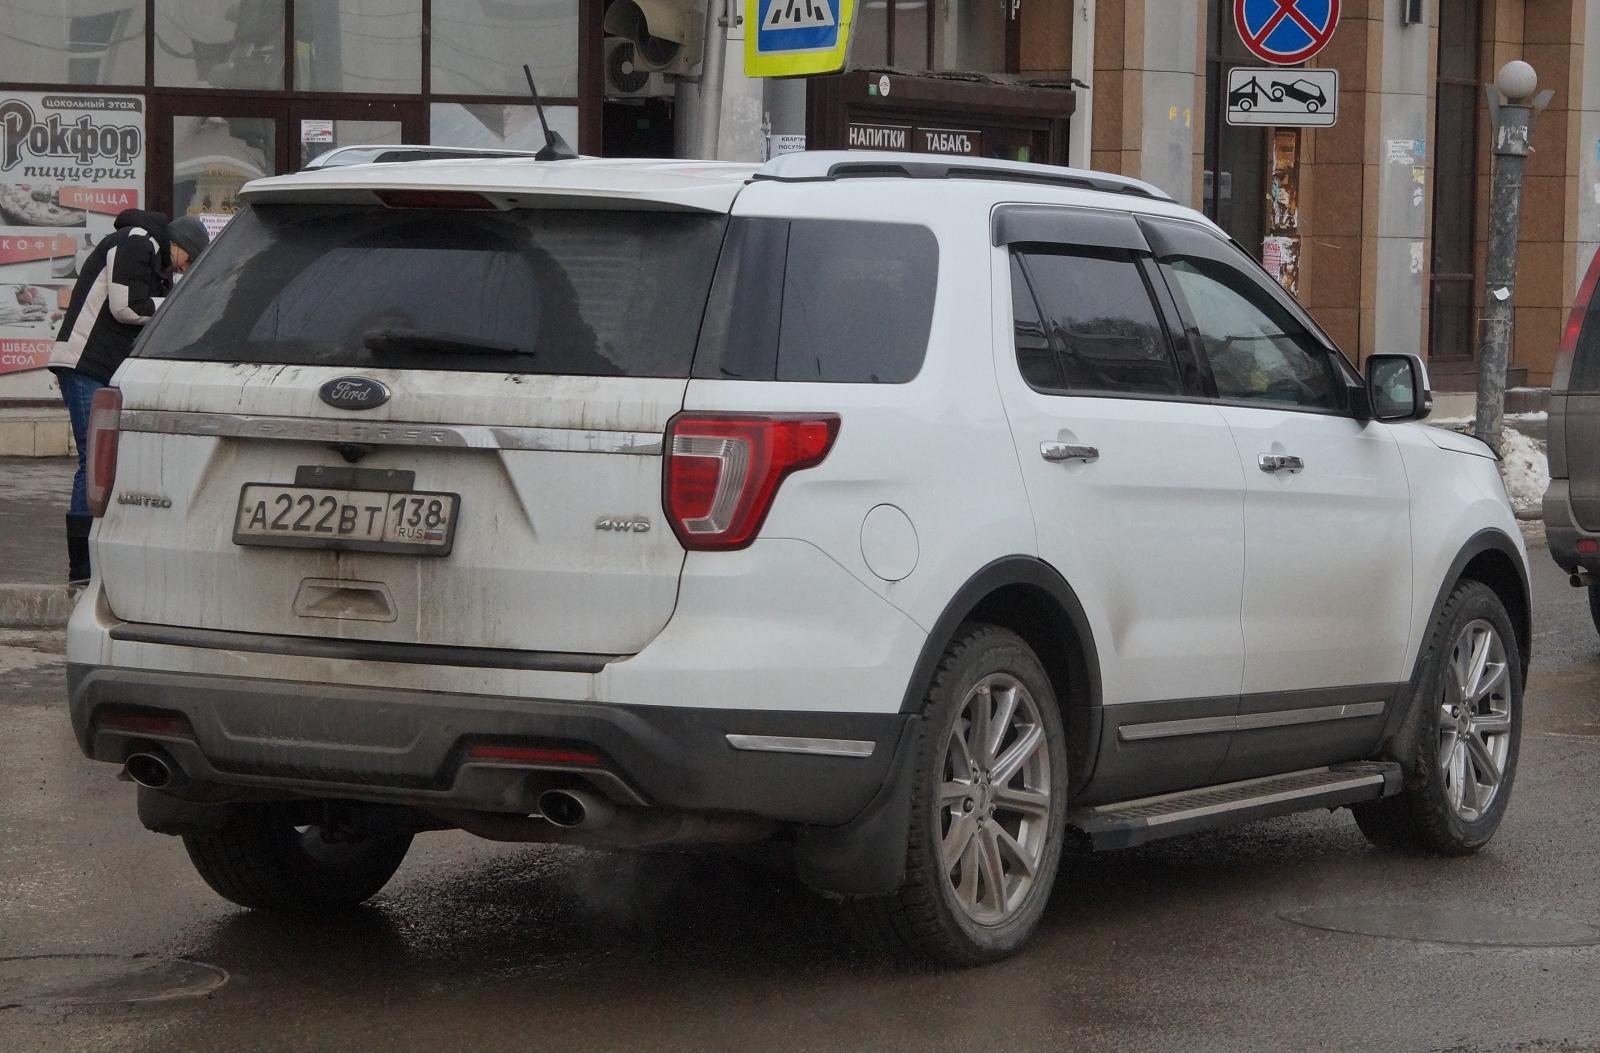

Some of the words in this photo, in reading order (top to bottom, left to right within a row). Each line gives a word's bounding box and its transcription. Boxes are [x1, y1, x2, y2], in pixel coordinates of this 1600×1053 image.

[0, 99, 141, 172] Рокфор
[849, 127, 905, 149] НАПИТКИ
[925, 132, 972, 153] ТАБАКЪ
[24, 166, 136, 182] пиццерия
[73, 192, 129, 205] ПИЦЦА
[2, 239, 59, 251] КОФЕ
[2, 354, 35, 366] СТОЛ
[331, 381, 371, 401] Ford
[248, 493, 382, 536] А222ВТ
[392, 497, 444, 528] 138
[398, 527, 424, 539] RUS
[595, 518, 650, 533] 4WD
